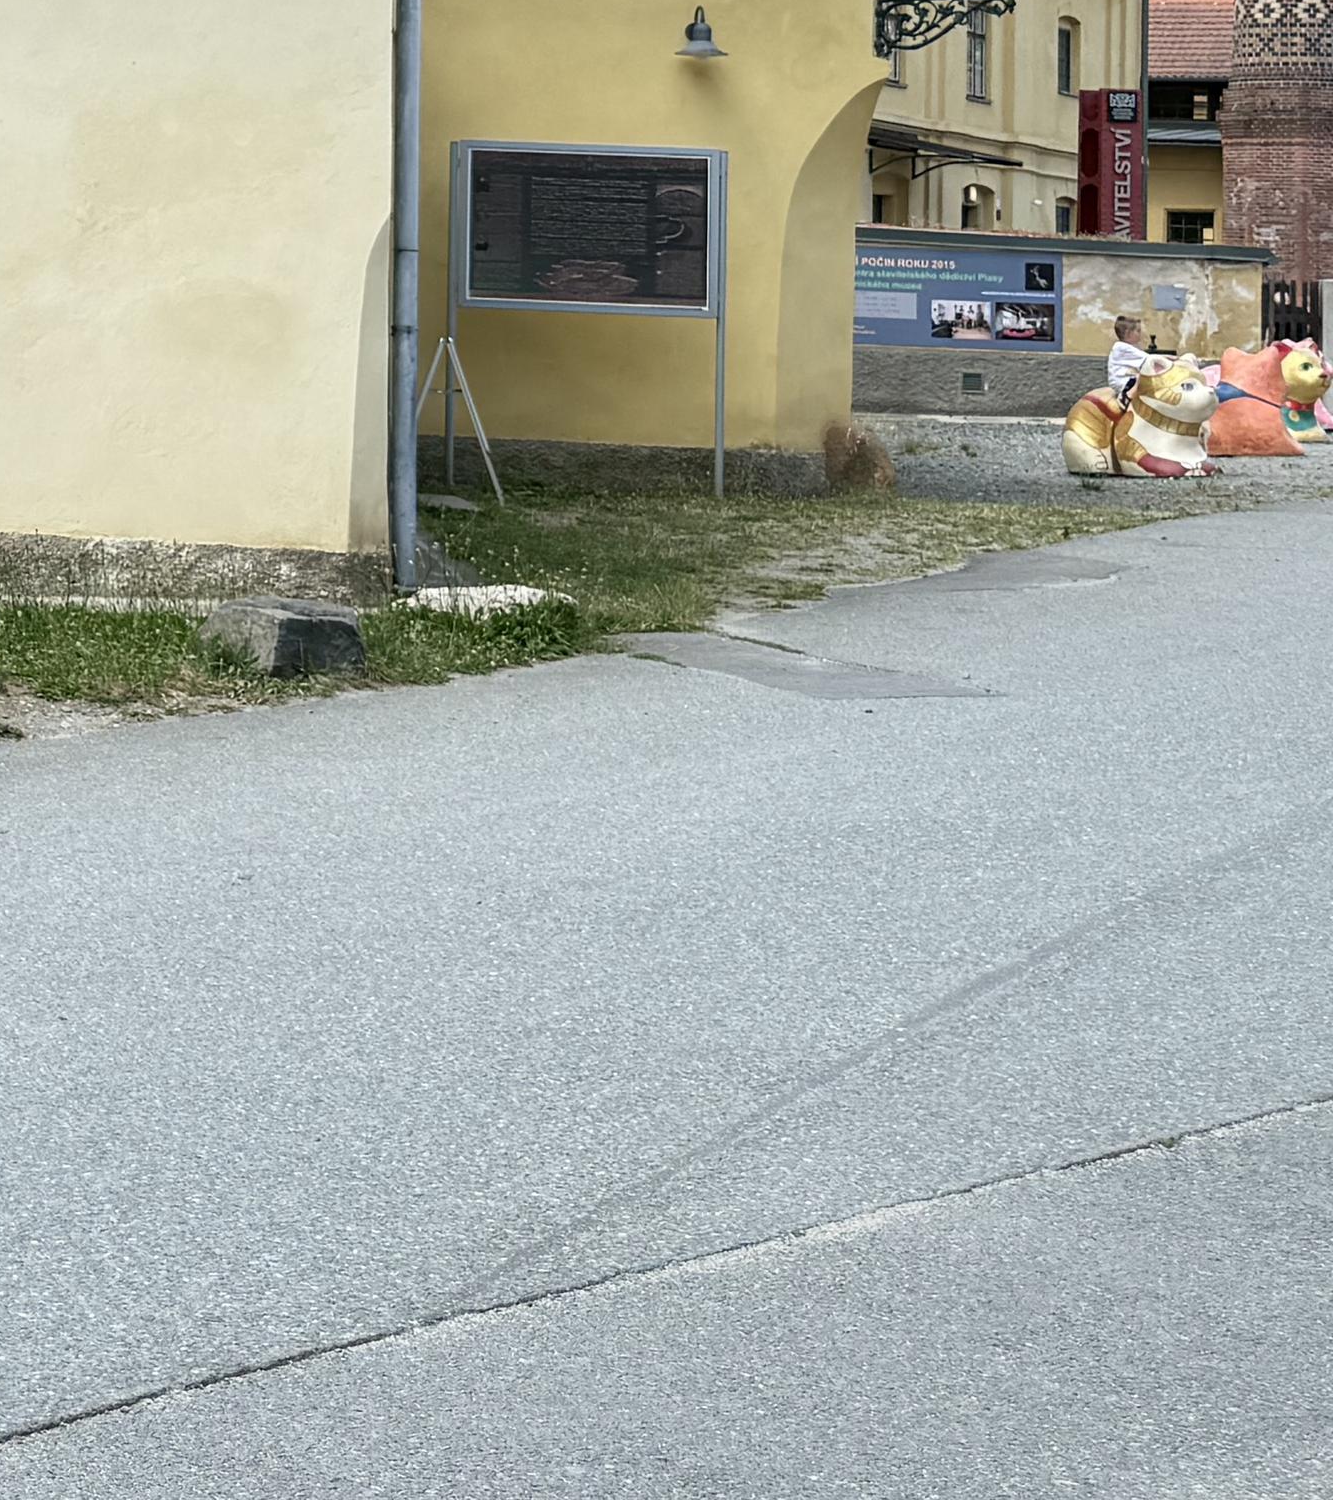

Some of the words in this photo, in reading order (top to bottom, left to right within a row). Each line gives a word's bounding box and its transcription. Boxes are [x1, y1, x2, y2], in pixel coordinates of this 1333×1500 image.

[861, 256, 895, 267] POČIN
[897, 258, 929, 268] ROKU
[931, 259, 955, 269] 2015
